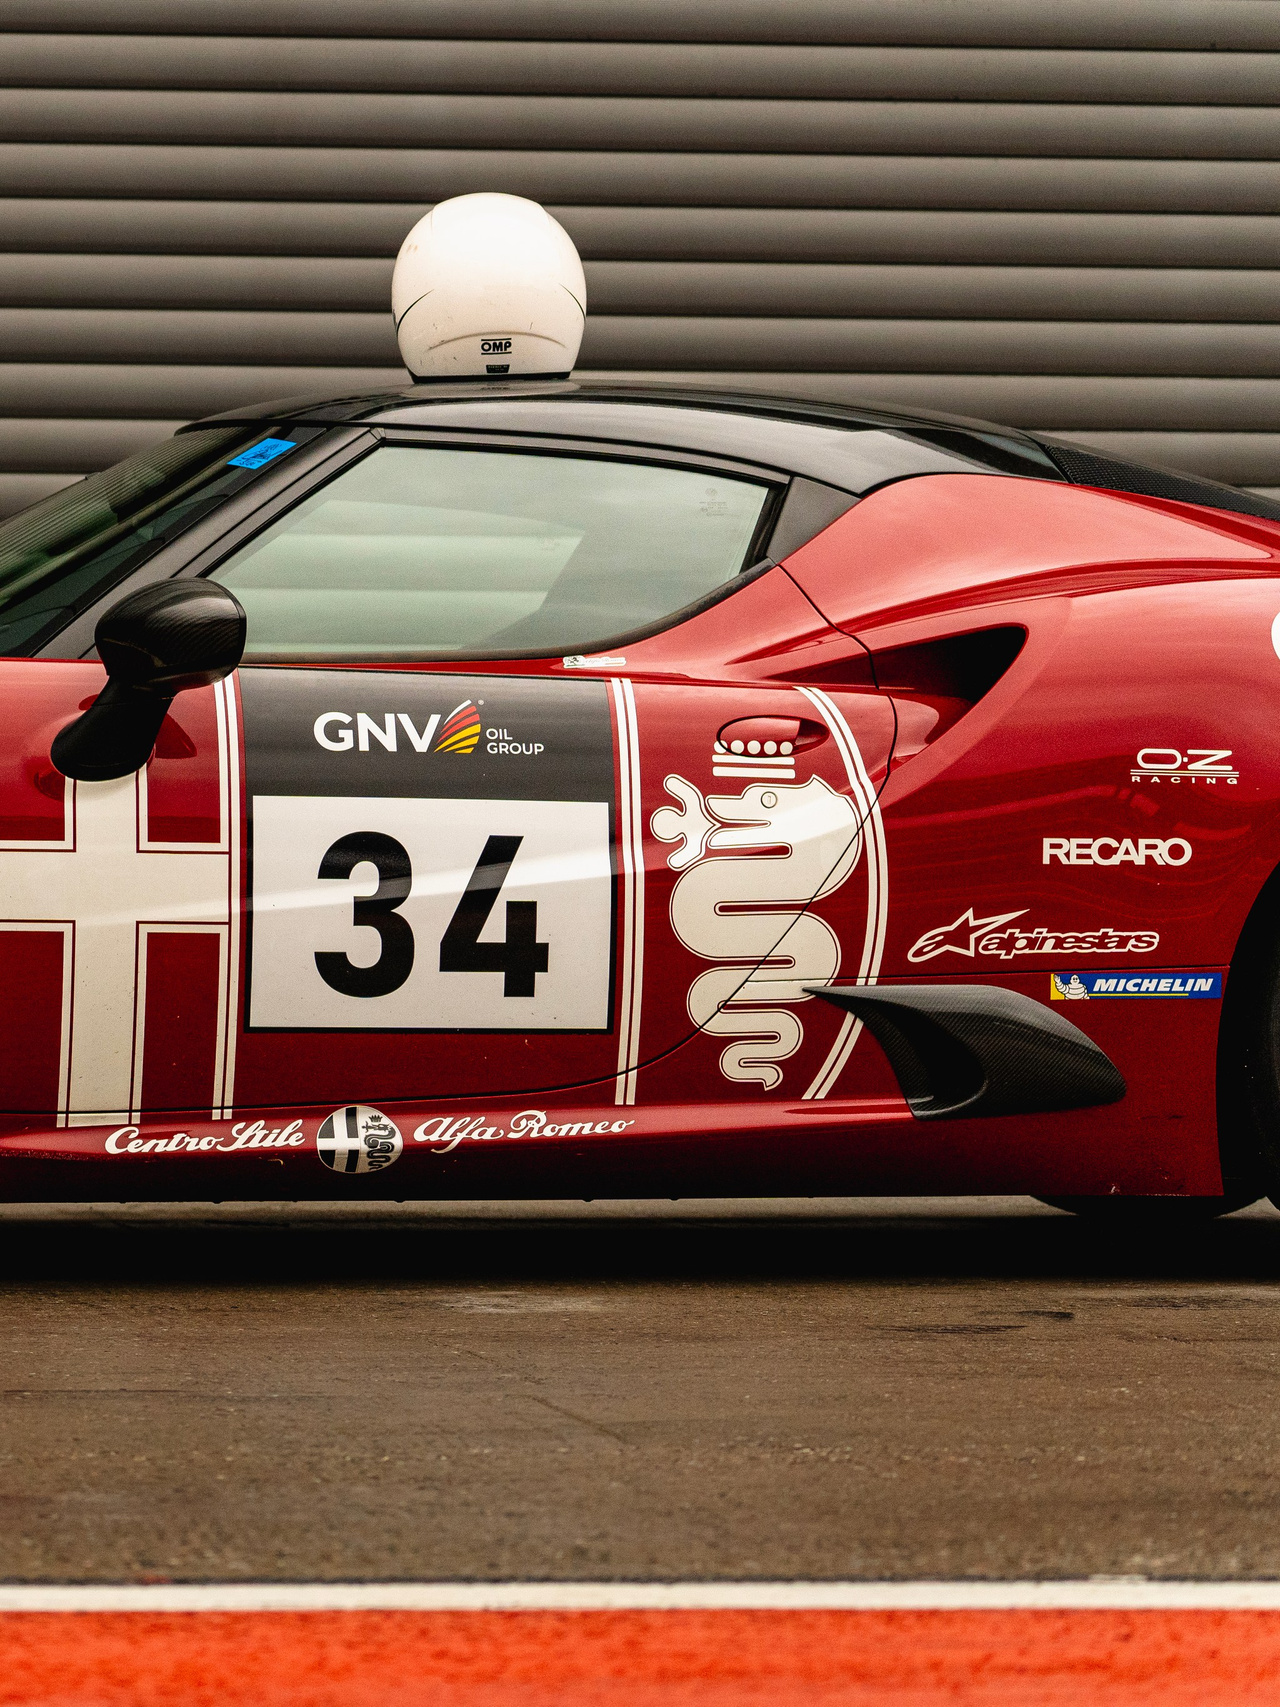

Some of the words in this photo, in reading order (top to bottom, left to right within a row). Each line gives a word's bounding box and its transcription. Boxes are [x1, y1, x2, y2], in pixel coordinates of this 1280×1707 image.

[481, 340, 512, 352] OMP
[313, 711, 441, 753] GNV
[486, 728, 513, 740] OIL
[486, 742, 545, 755] GROUP
[1131, 776, 1238, 785] RACING
[1042, 837, 1192, 866] RECARO
[314, 831, 549, 998] 34
[978, 928, 1160, 959] alpinestars
[1092, 978, 1214, 992] MICHELIN
[105, 1126, 224, 1154] Centro
[217, 1119, 306, 1152] Stile
[413, 1116, 504, 1154] Alfa
[507, 1110, 635, 1139] Romeo
